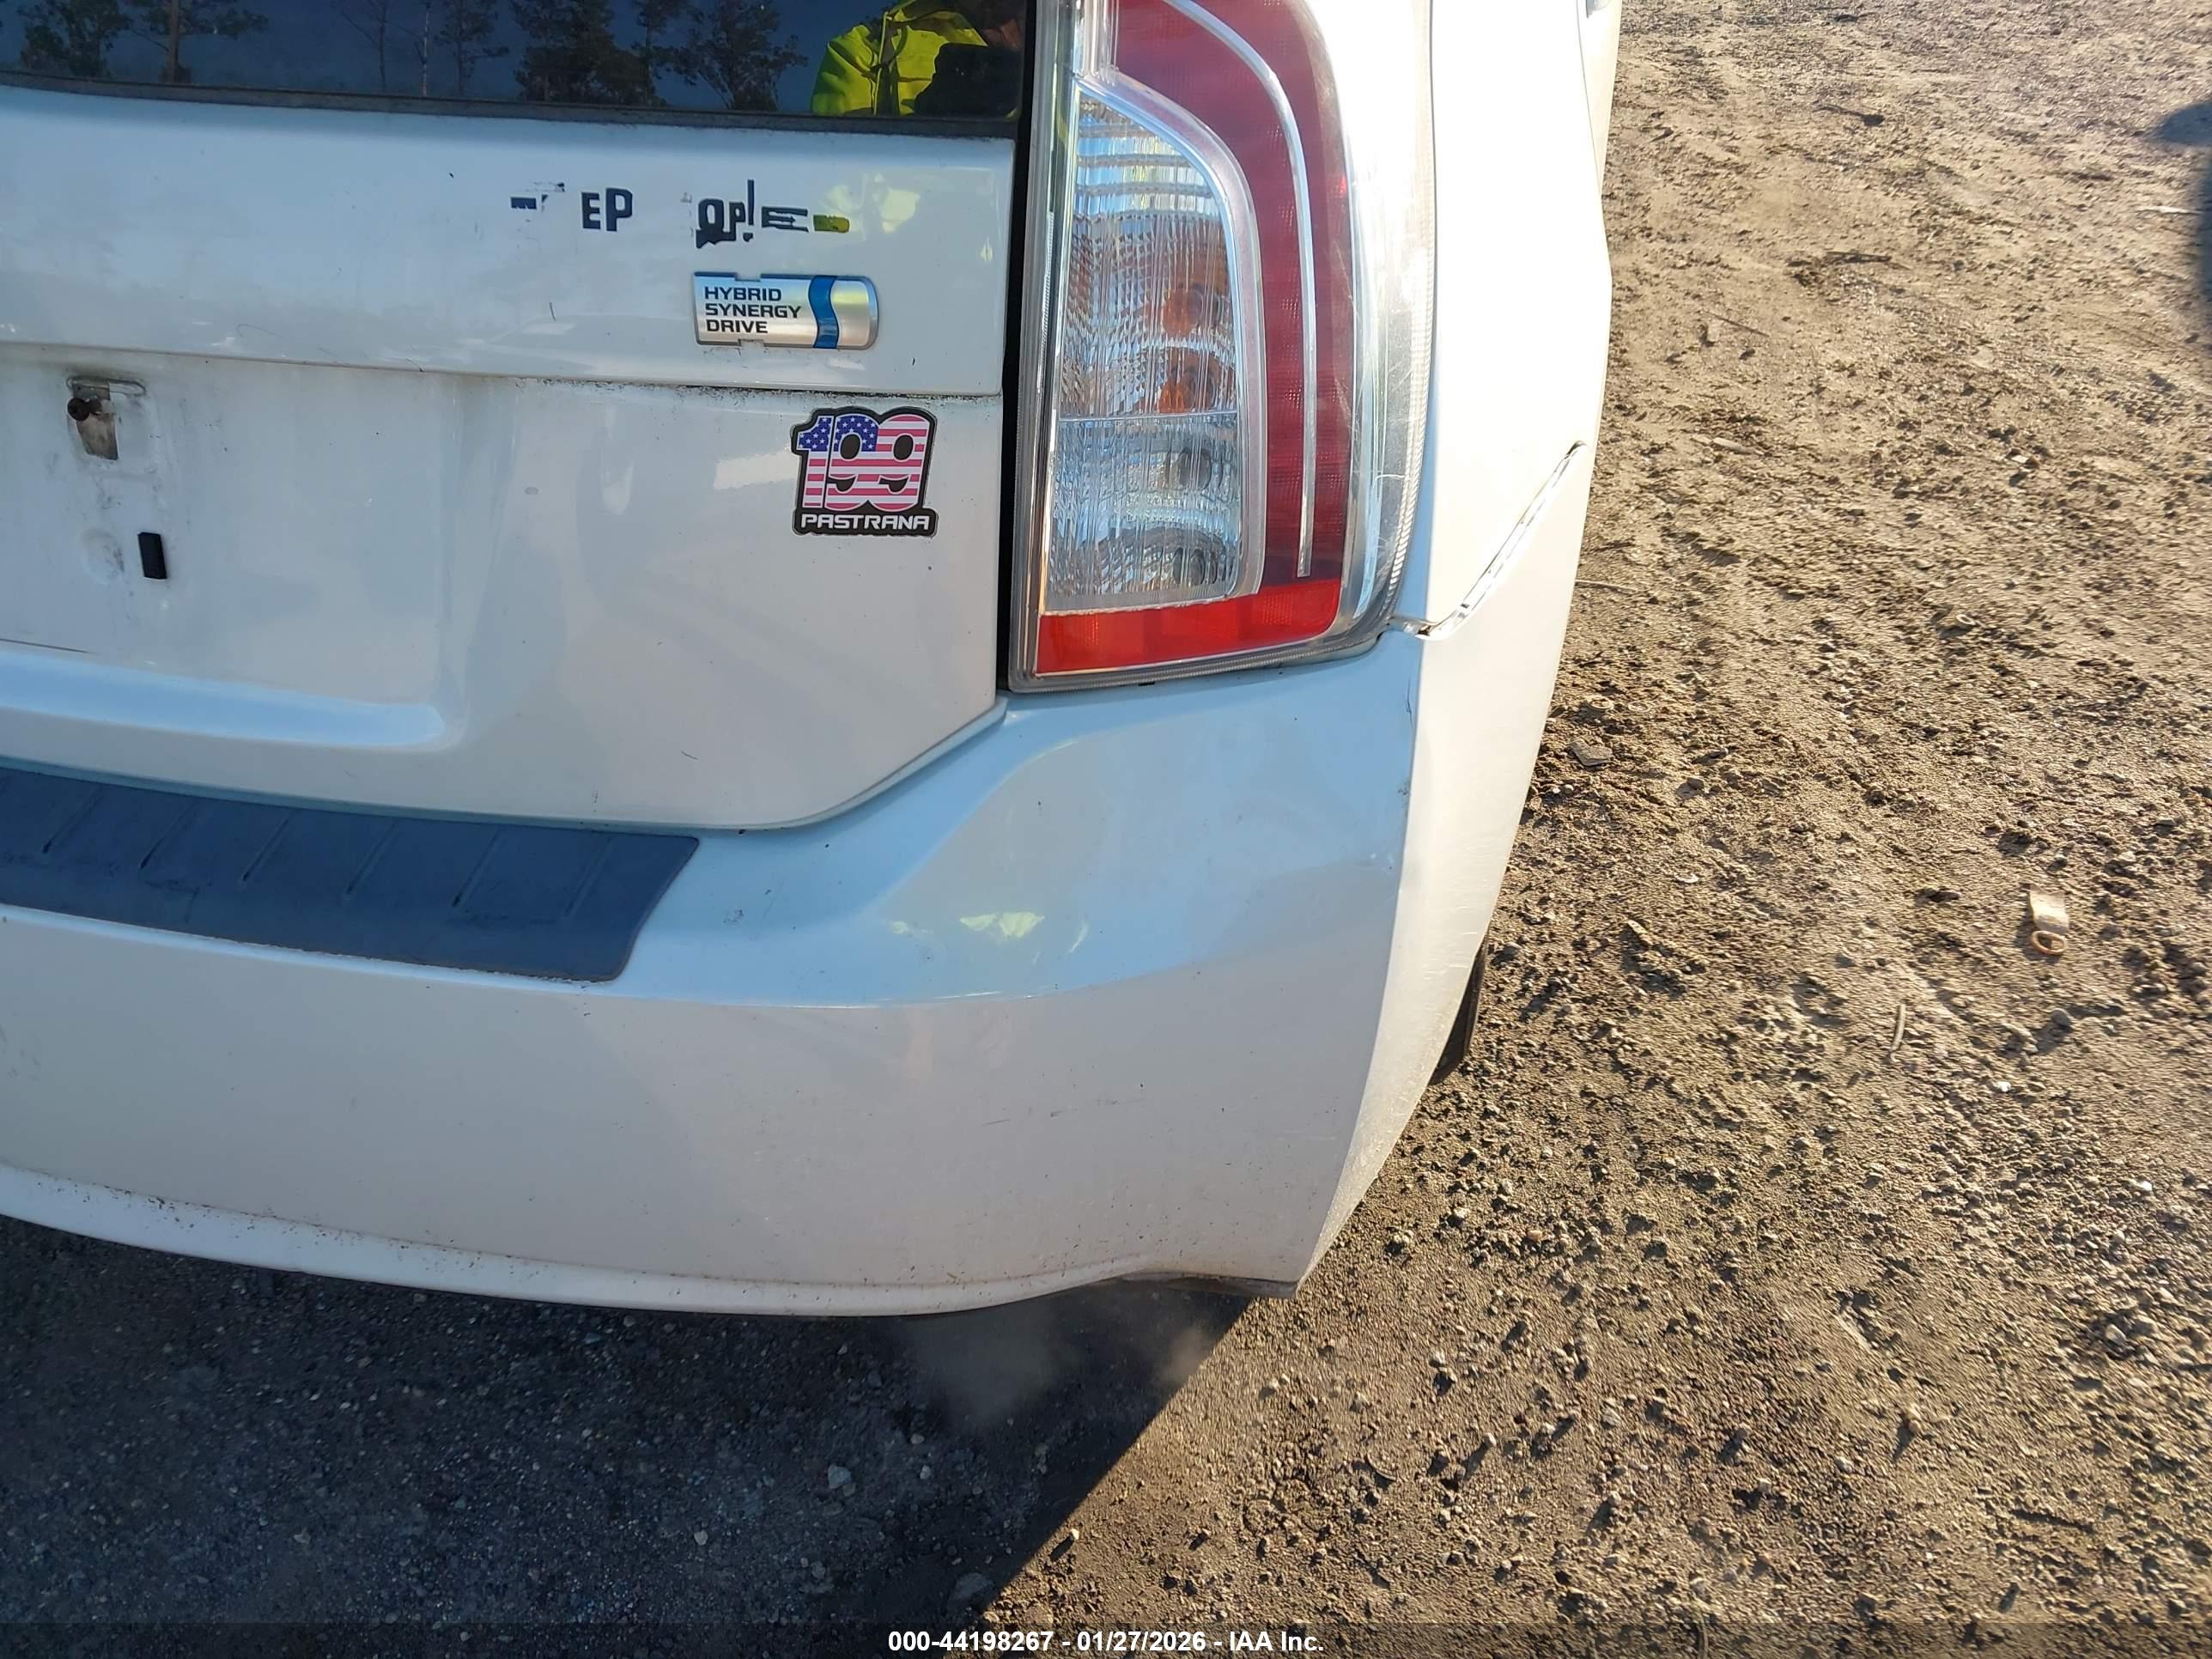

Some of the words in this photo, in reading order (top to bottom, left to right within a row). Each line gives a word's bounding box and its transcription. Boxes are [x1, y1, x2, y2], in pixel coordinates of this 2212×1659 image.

[704, 286, 782, 301] HYBRID
[705, 303, 802, 319] SYNERGY
[706, 319, 769, 333] DRIVE
[796, 413, 931, 513] 199
[800, 514, 930, 531] PASTRANA
